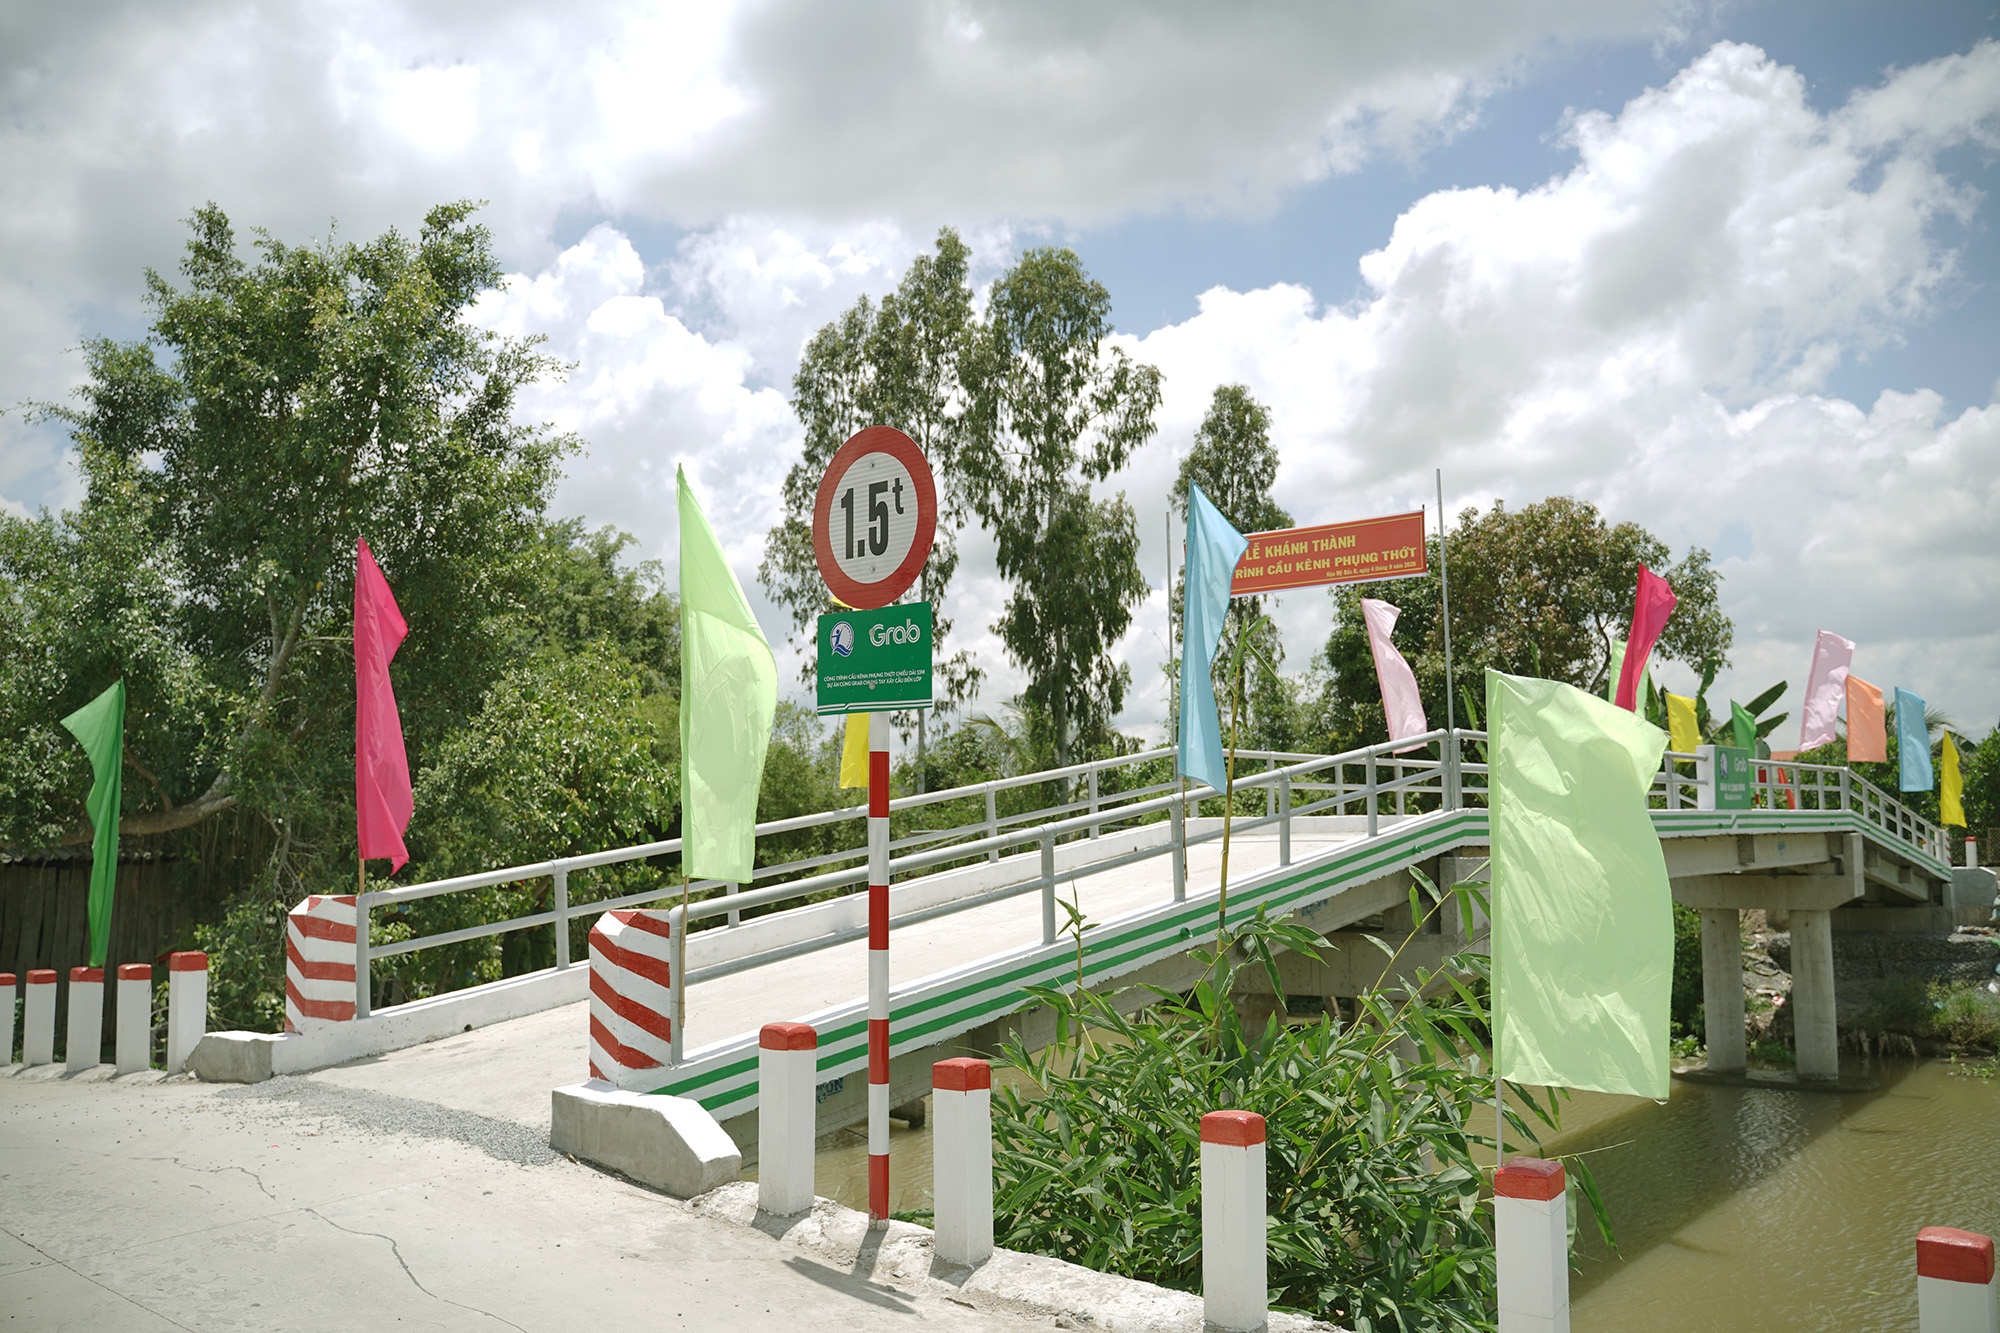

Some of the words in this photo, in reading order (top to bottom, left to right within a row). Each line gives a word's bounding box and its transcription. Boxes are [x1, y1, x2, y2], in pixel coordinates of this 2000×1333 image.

[1245, 542, 1260, 561] LỄ
[1265, 541, 1308, 558] KHÁNH
[1312, 535, 1355, 552] THÀNH
[1234, 566, 1263, 579] RÌNH
[1267, 560, 1292, 575] CẦU
[1296, 558, 1330, 572] KÊNH
[1334, 552, 1378, 567] PHỤNG
[1381, 547, 1416, 561] THỚT
[869, 619, 920, 646] Grab
